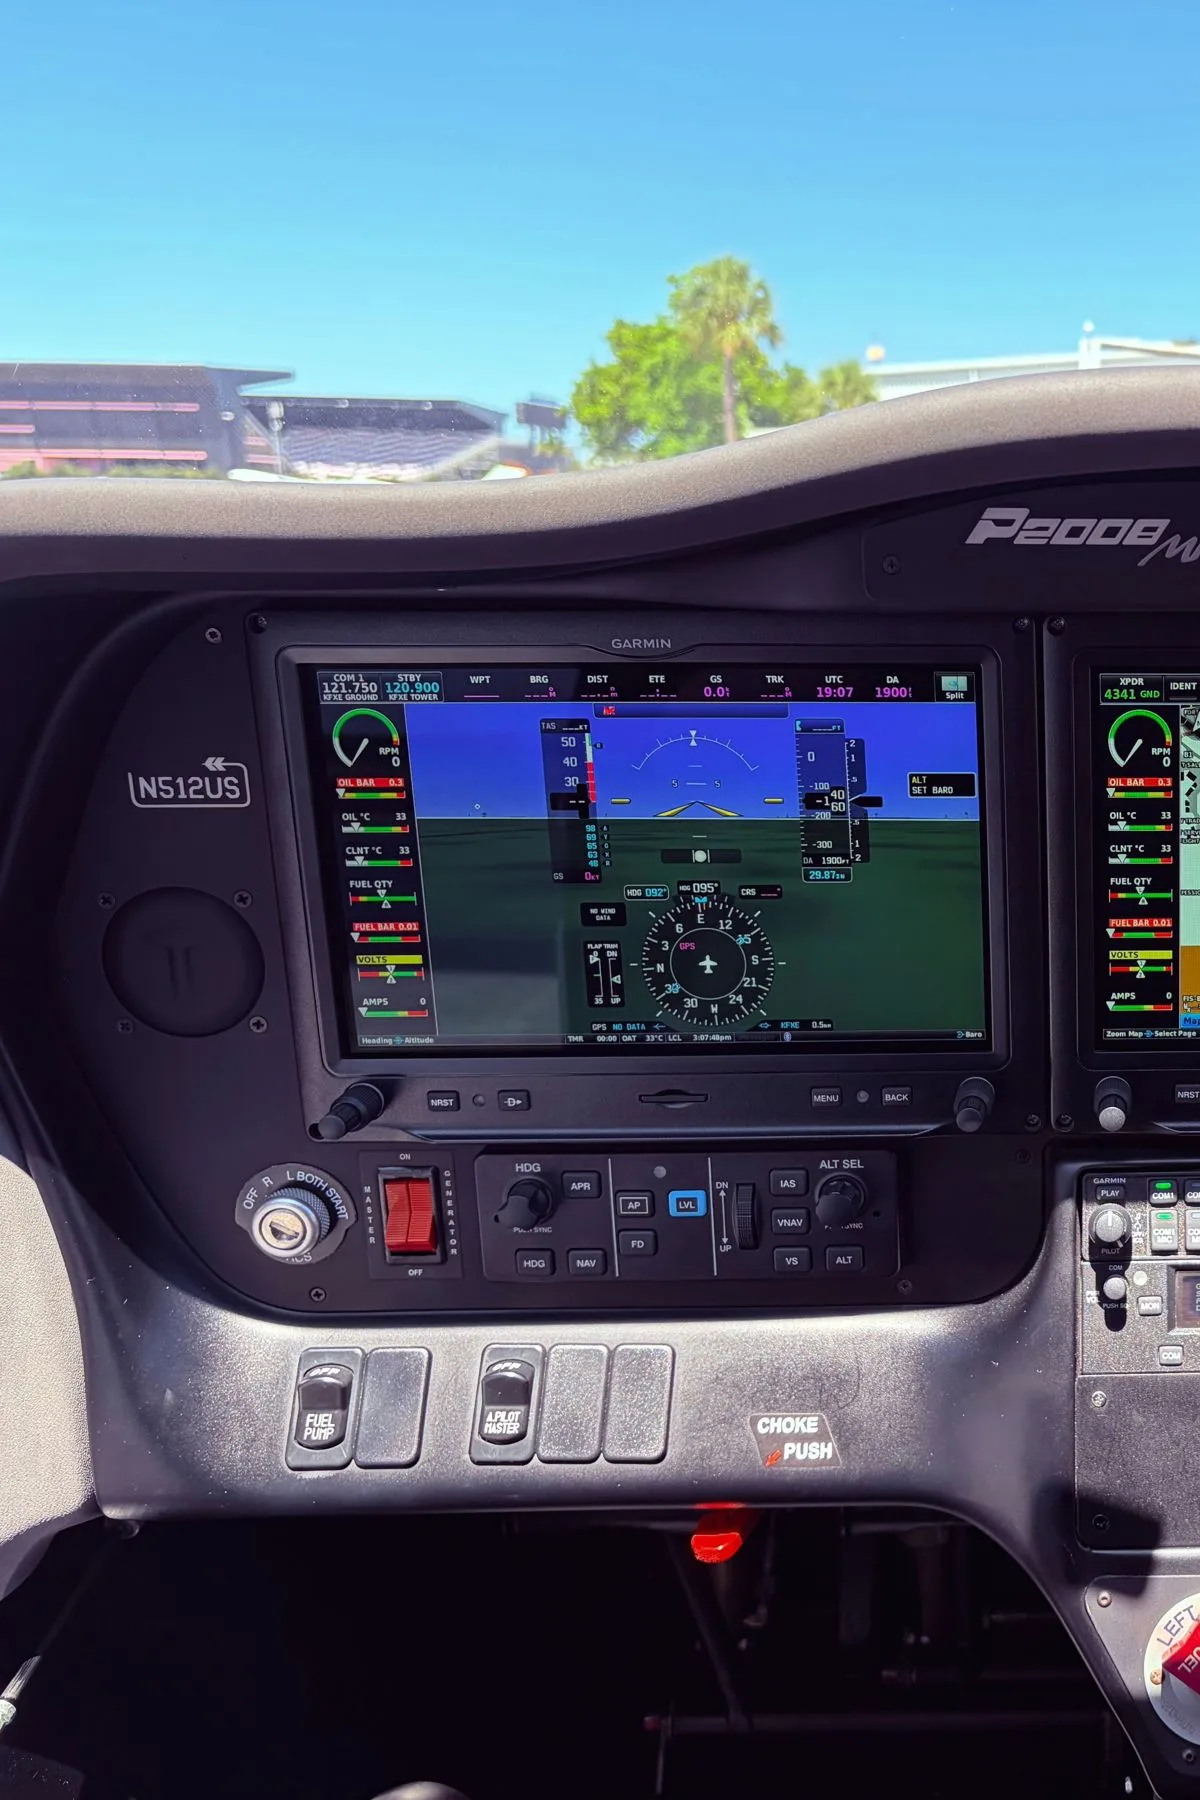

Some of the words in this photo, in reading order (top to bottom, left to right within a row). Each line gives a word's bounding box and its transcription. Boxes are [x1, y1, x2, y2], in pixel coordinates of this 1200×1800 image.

[965, 507, 1171, 546] P2008
[610, 636, 672, 649] GARMIN
[469, 675, 491, 684] WPT
[587, 675, 609, 684] DIST
[1119, 677, 1144, 686] XPDR
[322, 682, 378, 694] 121.750
[385, 682, 440, 694] 120.900
[1169, 682, 1197, 691] IDENT
[816, 686, 854, 698] 19:07
[945, 691, 965, 700] Split
[1104, 688, 1137, 700] 4341
[1140, 690, 1160, 699] GND
[338, 778, 355, 787] OIL
[356, 778, 376, 787] BAR
[911, 776, 927, 785] ALT
[138, 776, 240, 800] N512US
[912, 786, 928, 795] SET
[932, 786, 954, 795] BARO
[350, 880, 372, 889] FUEL
[374, 880, 393, 890] QTY
[354, 923, 376, 931] FUEL
[377, 923, 396, 931] BAR
[398, 923, 418, 931] 0.01
[358, 956, 388, 964] VOLTS
[362, 998, 389, 1007] AMPS
[813, 1094, 840, 1103] MENU
[884, 1093, 909, 1102] BACK
[431, 1099, 454, 1107] NRST
[515, 1162, 542, 1173] HDG
[819, 1160, 840, 1169] ALT
[842, 1160, 864, 1169] SEL
[296, 1170, 329, 1194] BOTH
[570, 1181, 591, 1191] APR
[780, 1179, 796, 1188] IAS
[1152, 1191, 1175, 1200] COM1
[323, 1186, 350, 1221] START
[627, 1202, 641, 1210] AP
[679, 1201, 695, 1209] LVL
[363, 1186, 376, 1244] MASTER
[443, 1170, 458, 1256] GENERATOR
[777, 1219, 803, 1227] VNAV
[631, 1240, 644, 1248] FD
[523, 1259, 546, 1269] HDG
[576, 1258, 597, 1268] NAV
[785, 1257, 799, 1265] VS
[835, 1256, 853, 1264] ALT
[408, 1268, 423, 1276] OFF
[305, 1413, 335, 1428] FUEL
[756, 1416, 819, 1433] CHOKE
[484, 1421, 520, 1435] MASTER
[303, 1425, 335, 1441] PUMP
[783, 1442, 833, 1460] PUSH
[1156, 1604, 1199, 1647] LEFT
